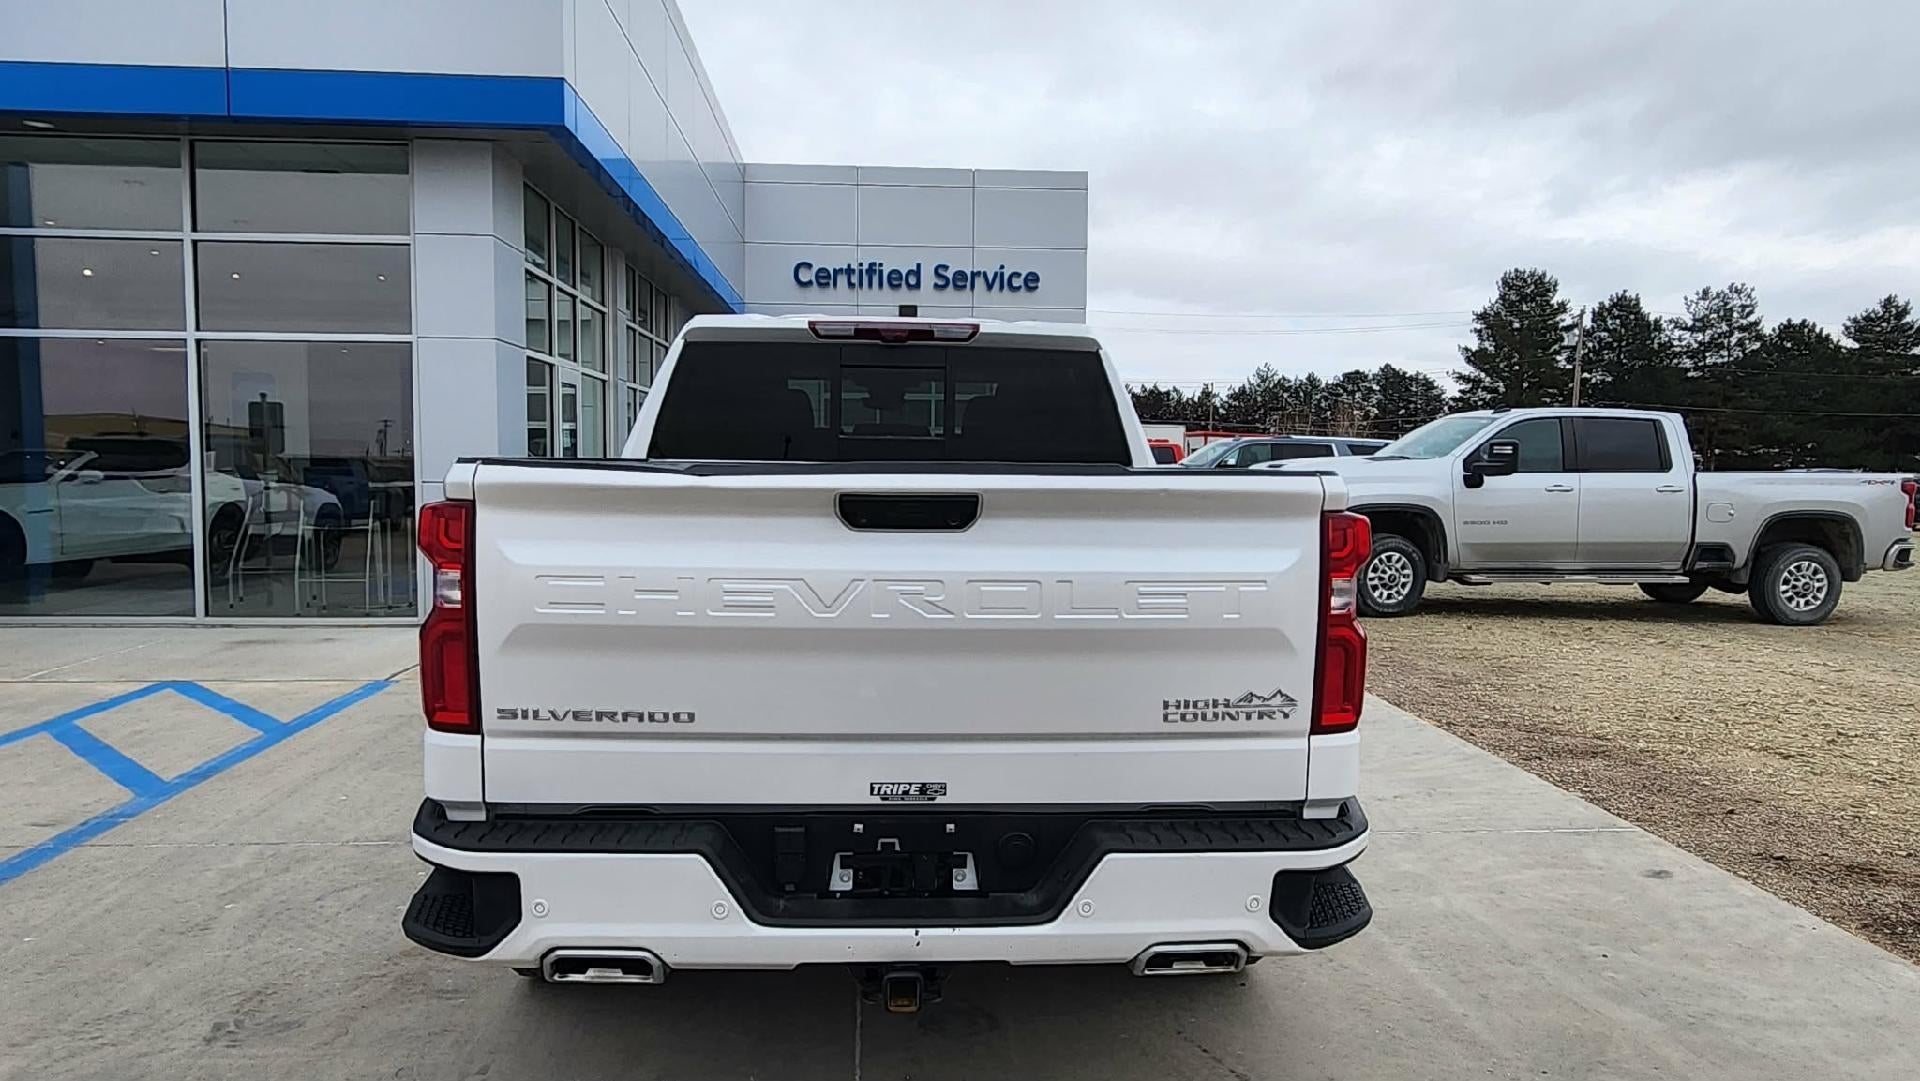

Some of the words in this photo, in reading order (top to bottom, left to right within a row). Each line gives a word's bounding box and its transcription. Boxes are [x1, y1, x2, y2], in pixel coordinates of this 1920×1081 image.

[793, 262, 921, 290] Certified
[932, 263, 1041, 292] Service
[535, 575, 1267, 619] CHEVROLET
[1163, 698, 1231, 710] HIGH
[496, 707, 696, 724] SILVERADO
[1163, 709, 1297, 723] COUNTRY
[872, 783, 922, 795] TRIPE
